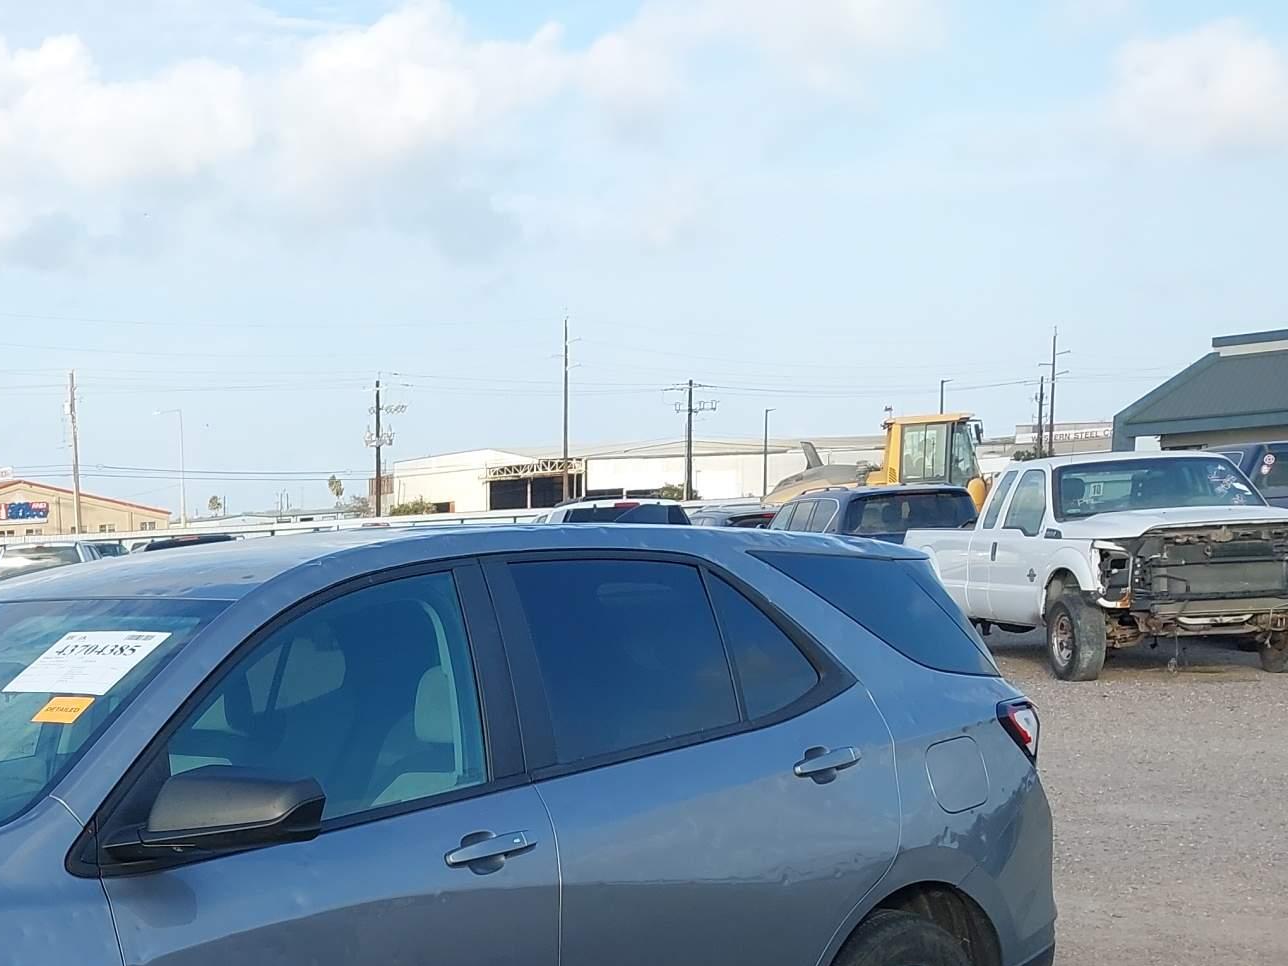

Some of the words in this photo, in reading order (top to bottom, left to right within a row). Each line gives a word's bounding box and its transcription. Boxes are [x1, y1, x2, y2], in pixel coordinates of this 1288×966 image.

[1031, 432, 1071, 442] WSERN
[1074, 430, 1100, 440] STEEL
[55, 643, 143, 657] 43704385
